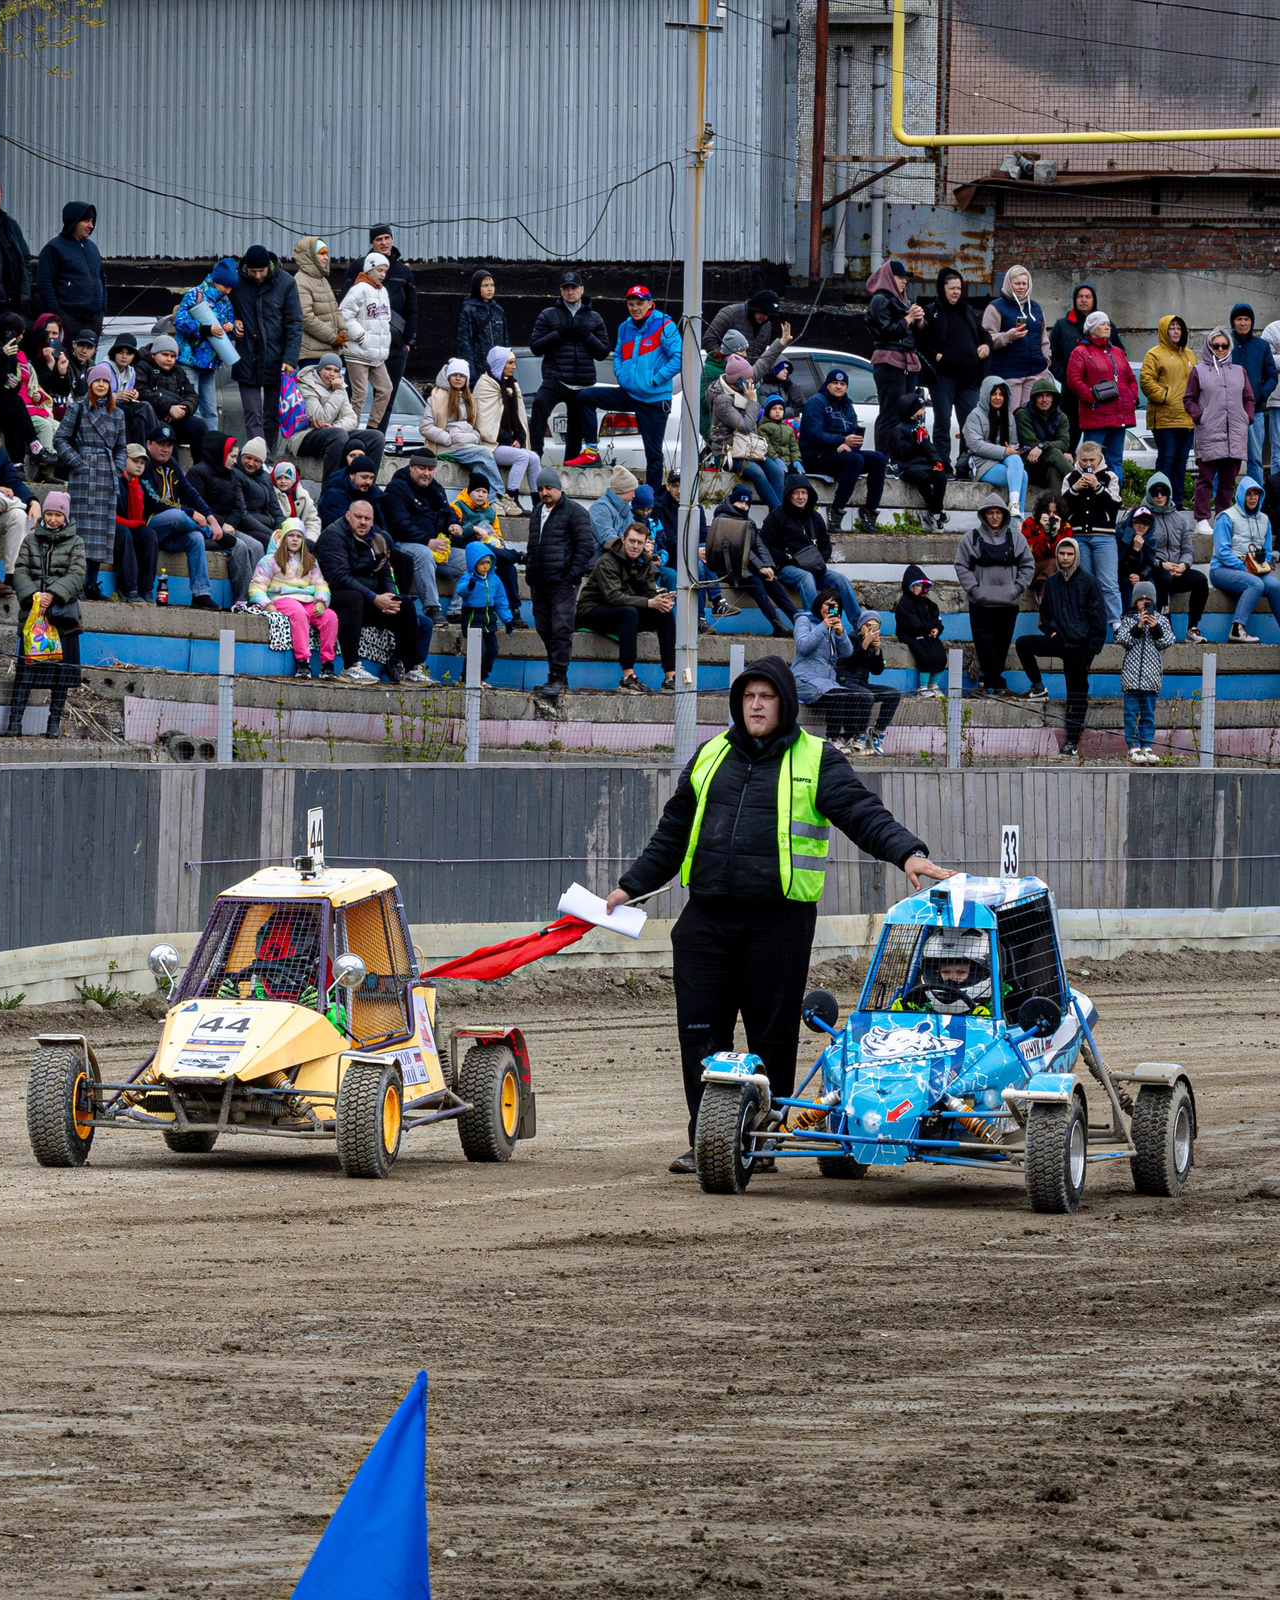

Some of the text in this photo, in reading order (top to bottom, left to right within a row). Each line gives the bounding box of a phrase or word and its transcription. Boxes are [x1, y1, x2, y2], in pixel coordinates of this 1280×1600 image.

[310, 818, 323, 855] 44
[1003, 831, 1018, 875] 33
[198, 1016, 252, 1033] 44
[844, 1050, 958, 1073] KAMA TYRES
